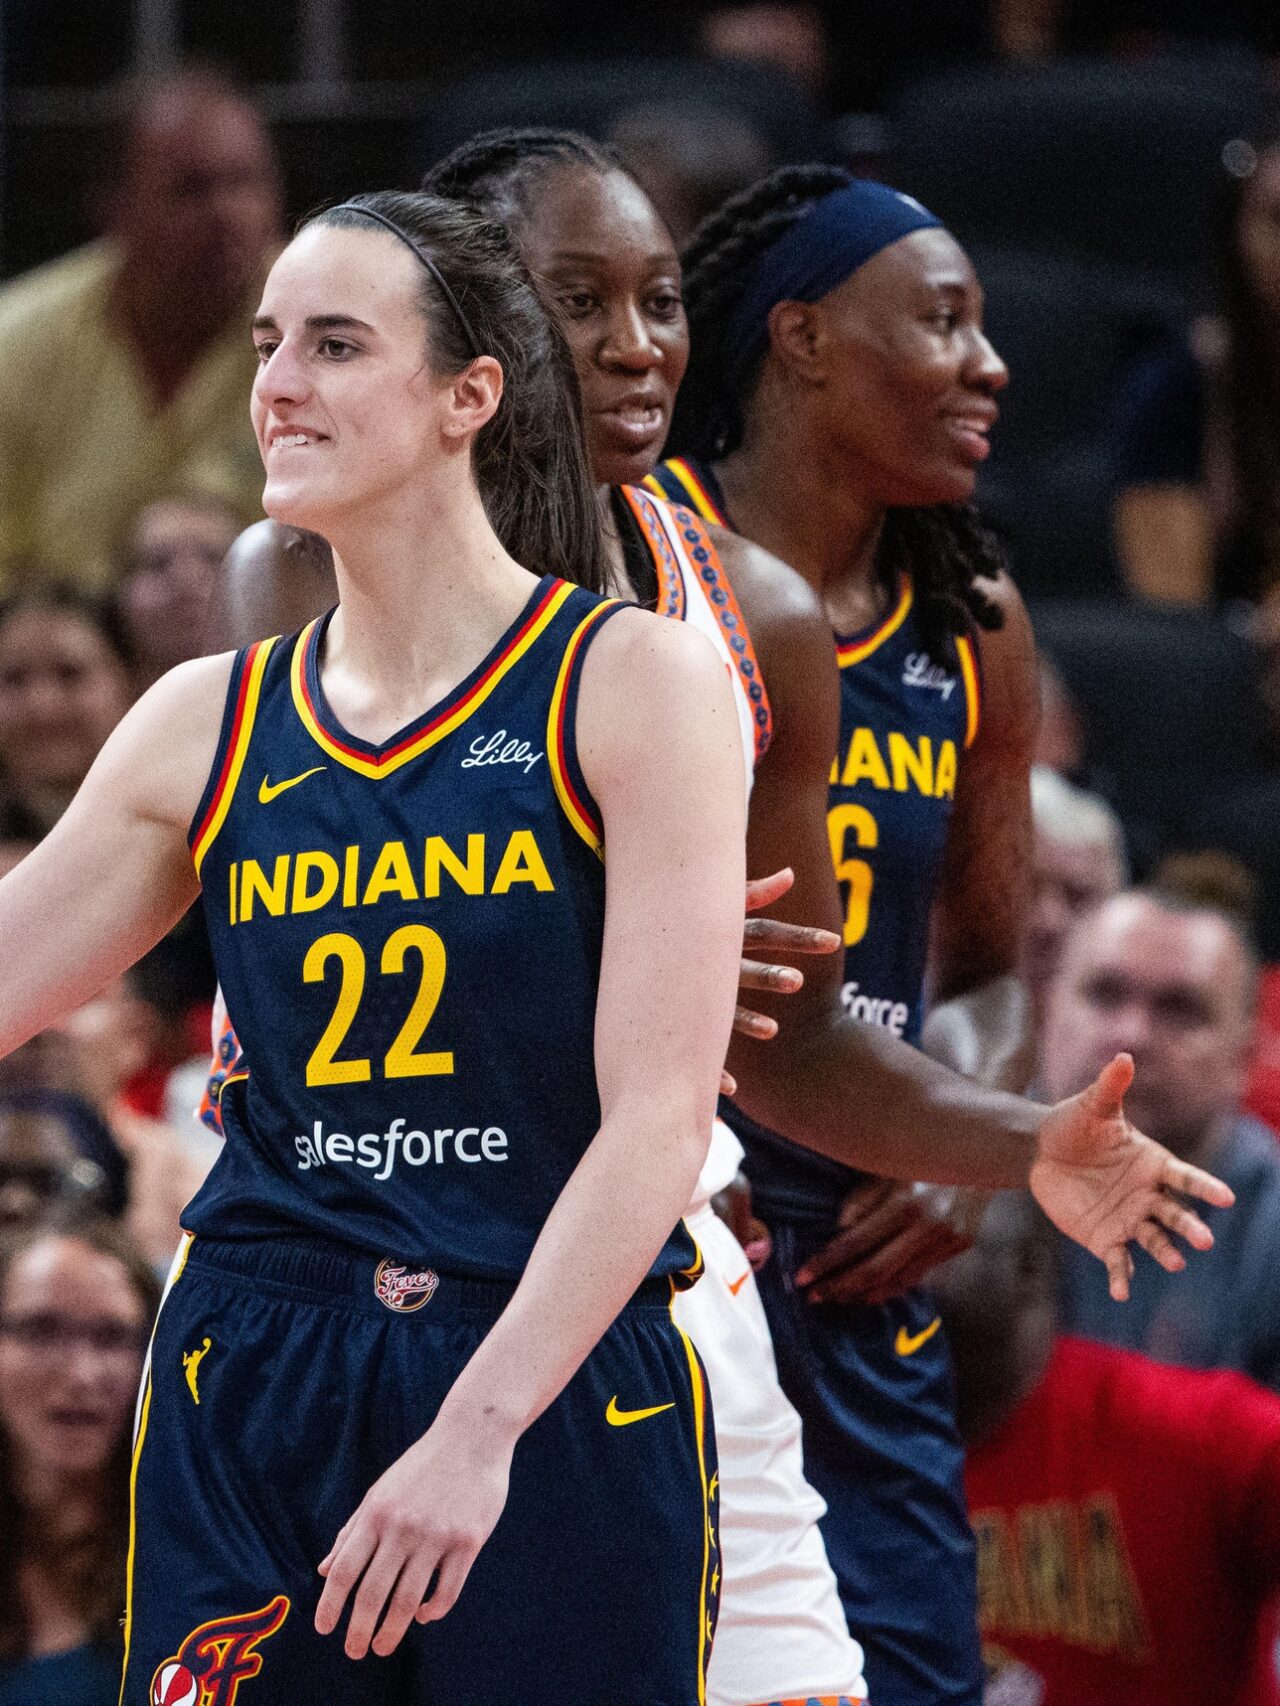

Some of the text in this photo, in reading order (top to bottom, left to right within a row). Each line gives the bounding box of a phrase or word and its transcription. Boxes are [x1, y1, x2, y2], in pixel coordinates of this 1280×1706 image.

[461, 729, 544, 774] Lilly
[828, 726, 958, 801] ANA
[229, 829, 555, 926] INDIANA
[302, 924, 454, 1087] 22
[294, 1118, 508, 1180] salesforce
[377, 1266, 439, 1297] Fever
